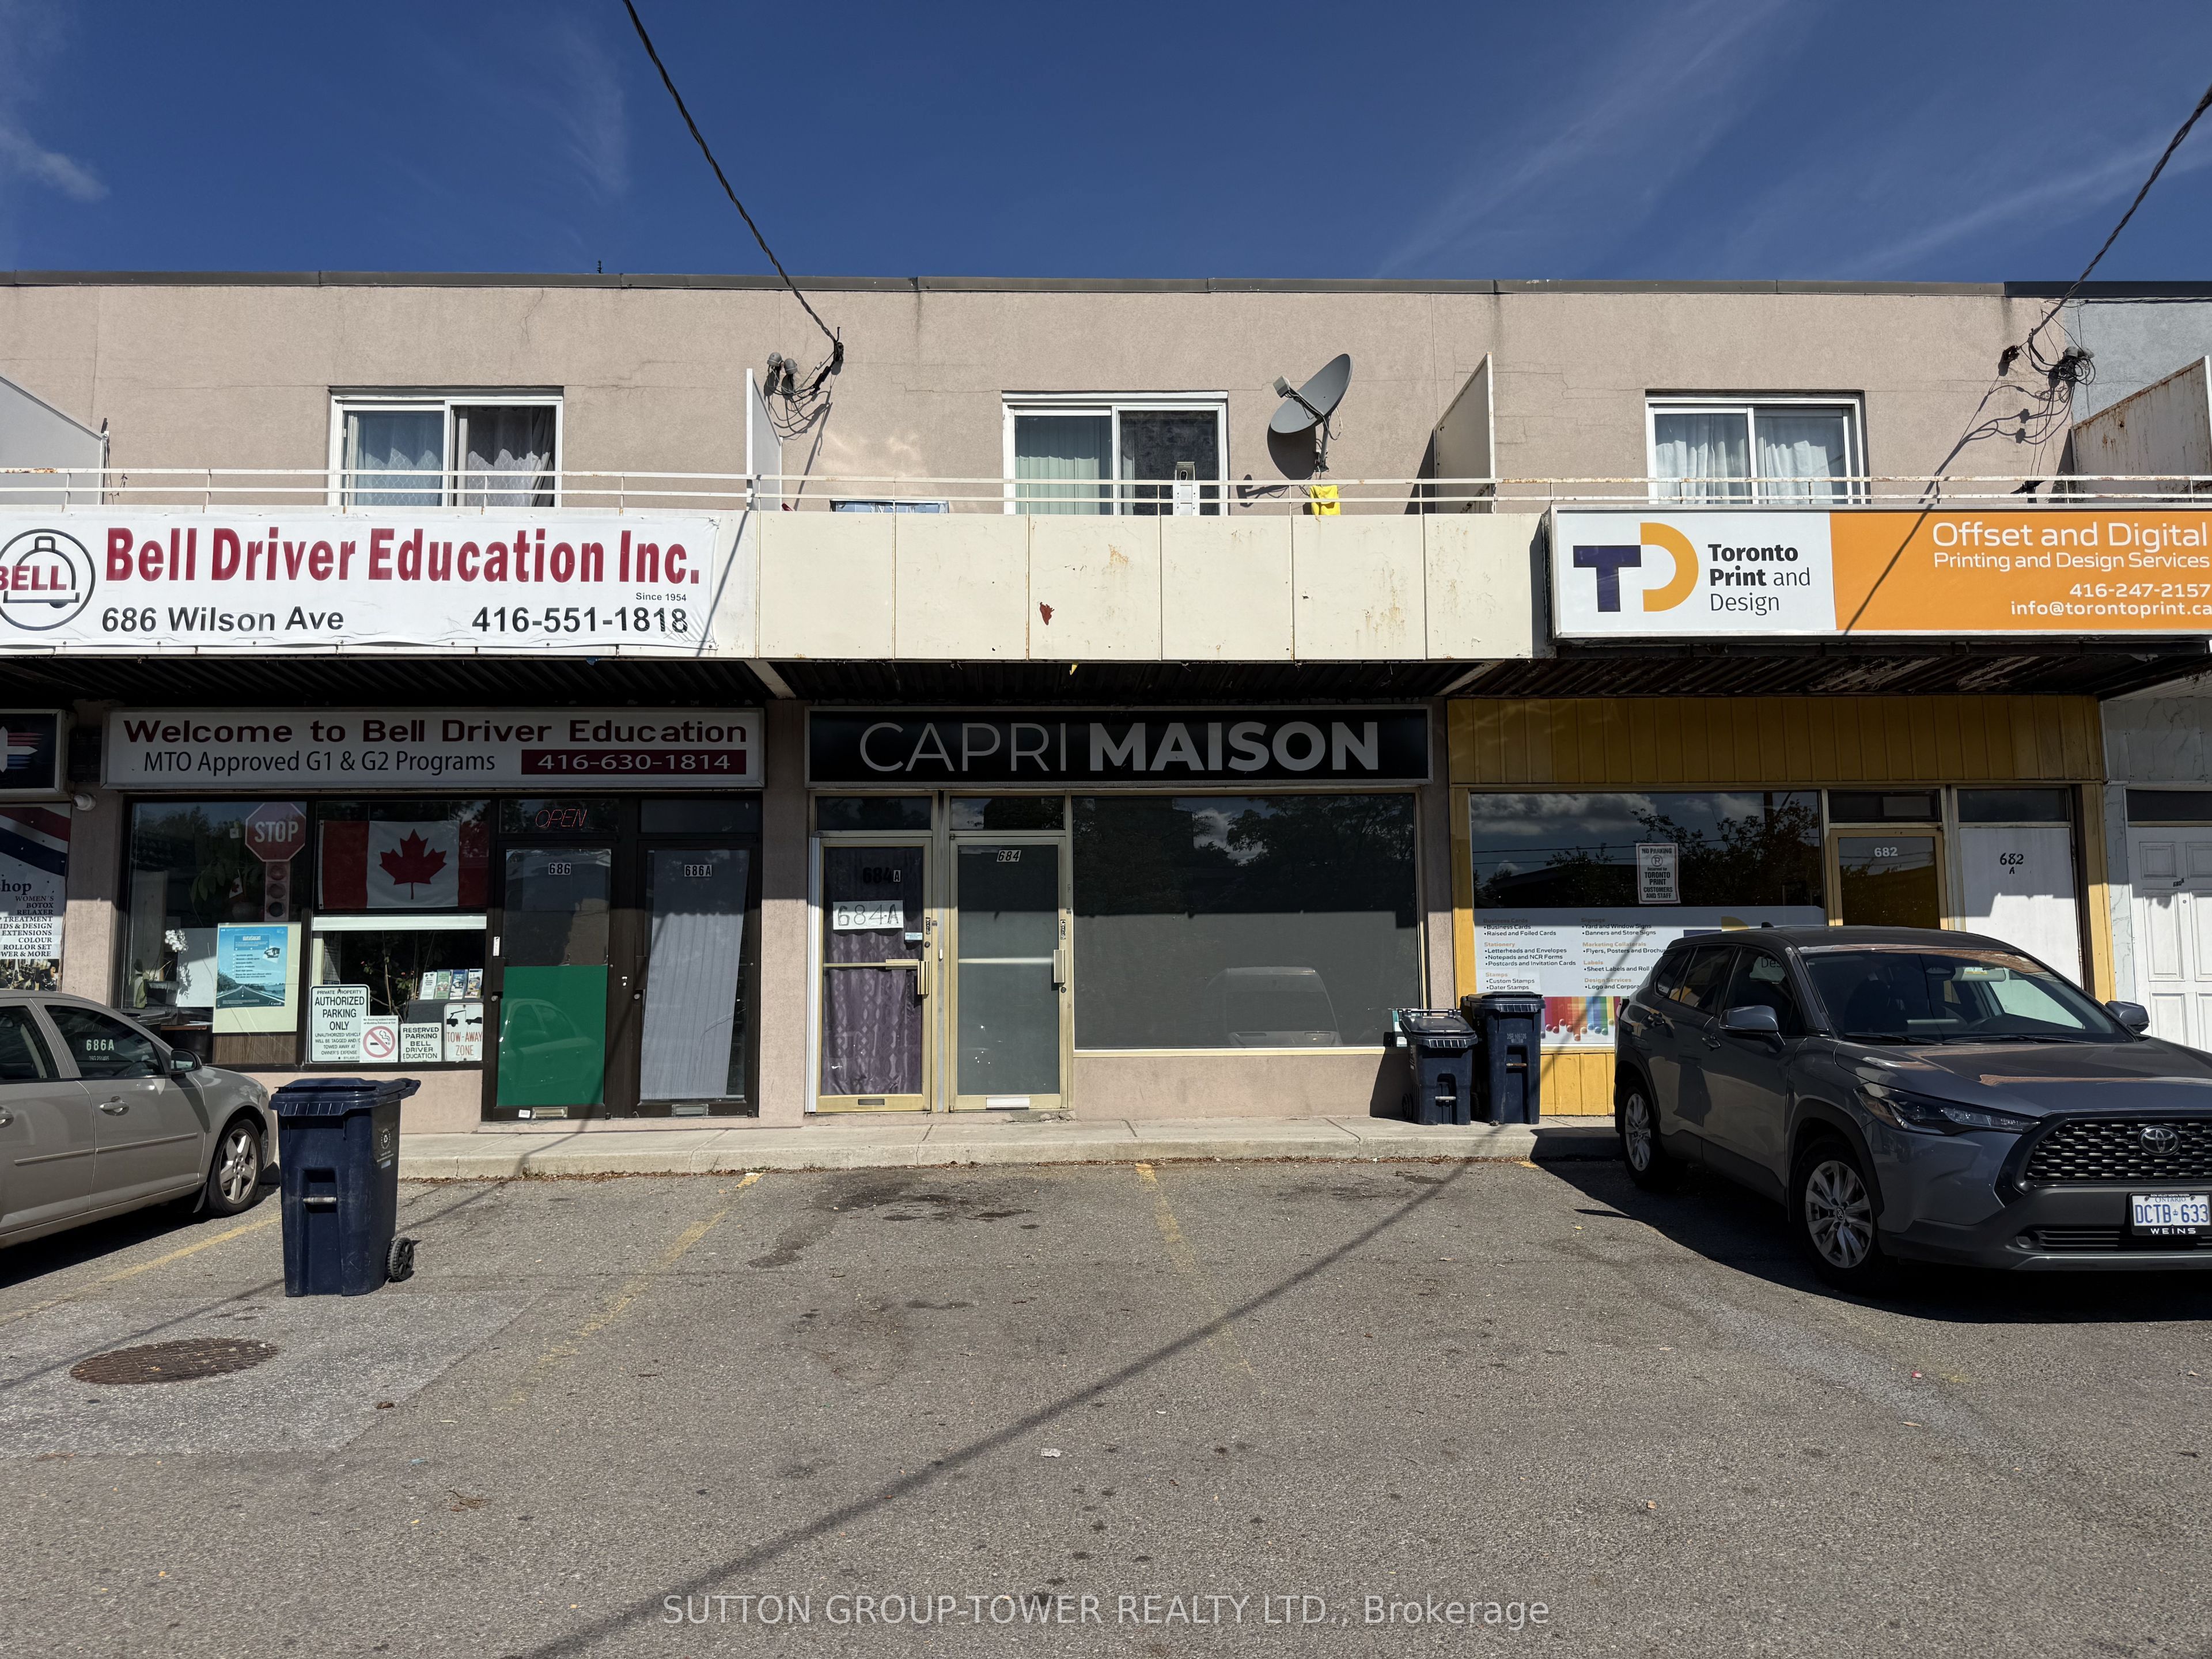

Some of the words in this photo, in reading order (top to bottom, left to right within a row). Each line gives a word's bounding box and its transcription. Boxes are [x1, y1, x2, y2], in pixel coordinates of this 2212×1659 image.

[1933, 521, 2032, 547] Offset
[2041, 521, 2098, 547] and
[2109, 522, 2207, 553] Digital
[106, 527, 197, 582] Bell
[211, 527, 355, 581] Driver
[369, 528, 604, 583] Education
[620, 530, 699, 584] Inc.
[1708, 544, 1798, 562] Toronto
[1934, 552, 2010, 572] Printing
[2015, 552, 2051, 568] and
[2056, 552, 2123, 572] Design
[2128, 552, 2210, 568] Services
[1710, 566, 1766, 586] Print
[1774, 567, 1810, 586] and
[636, 592, 662, 601] Since
[665, 592, 687, 602] 1954
[2069, 583, 2211, 598] 416-247-2157
[1711, 592, 1780, 616] Design
[2011, 600, 2212, 619] info@torontoprint.ca
[103, 607, 157, 632] 686
[168, 606, 275, 632] Wilson
[285, 605, 344, 631] Ave
[472, 606, 689, 634] 416-551-1818
[124, 719, 293, 743] Welcome
[310, 719, 346, 743] to
[363, 719, 425, 743] Bell
[442, 719, 551, 743] Driver
[570, 719, 747, 743] Education
[860, 722, 1066, 772] CAPRI
[1090, 721, 1378, 772] MAISON
[144, 751, 192, 771] MTO
[198, 750, 299, 776] Approved
[306, 750, 332, 771] G1
[340, 751, 356, 771] &
[362, 750, 389, 771] G2
[396, 750, 495, 776] Programs
[537, 754, 730, 770] 416-630-1814
[535, 809, 587, 827] OPEN
[254, 821, 298, 842] STOP
[998, 851, 1020, 861] 684
[1874, 847, 1898, 857] 682
[1999, 853, 2024, 865] 682
[549, 863, 570, 874] 686
[685, 865, 711, 876] 686A
[2009, 866, 2015, 874] A
[315, 997, 365, 1006] AUTHORIZED
[323, 1009, 357, 1018] PARKING
[329, 1021, 350, 1031] ONLY
[86, 1039, 115, 1051] 686A
[456, 1045, 474, 1056] ZONE
[2135, 1205, 2172, 1223] DCTB
[2181, 1204, 2209, 1223] 633
